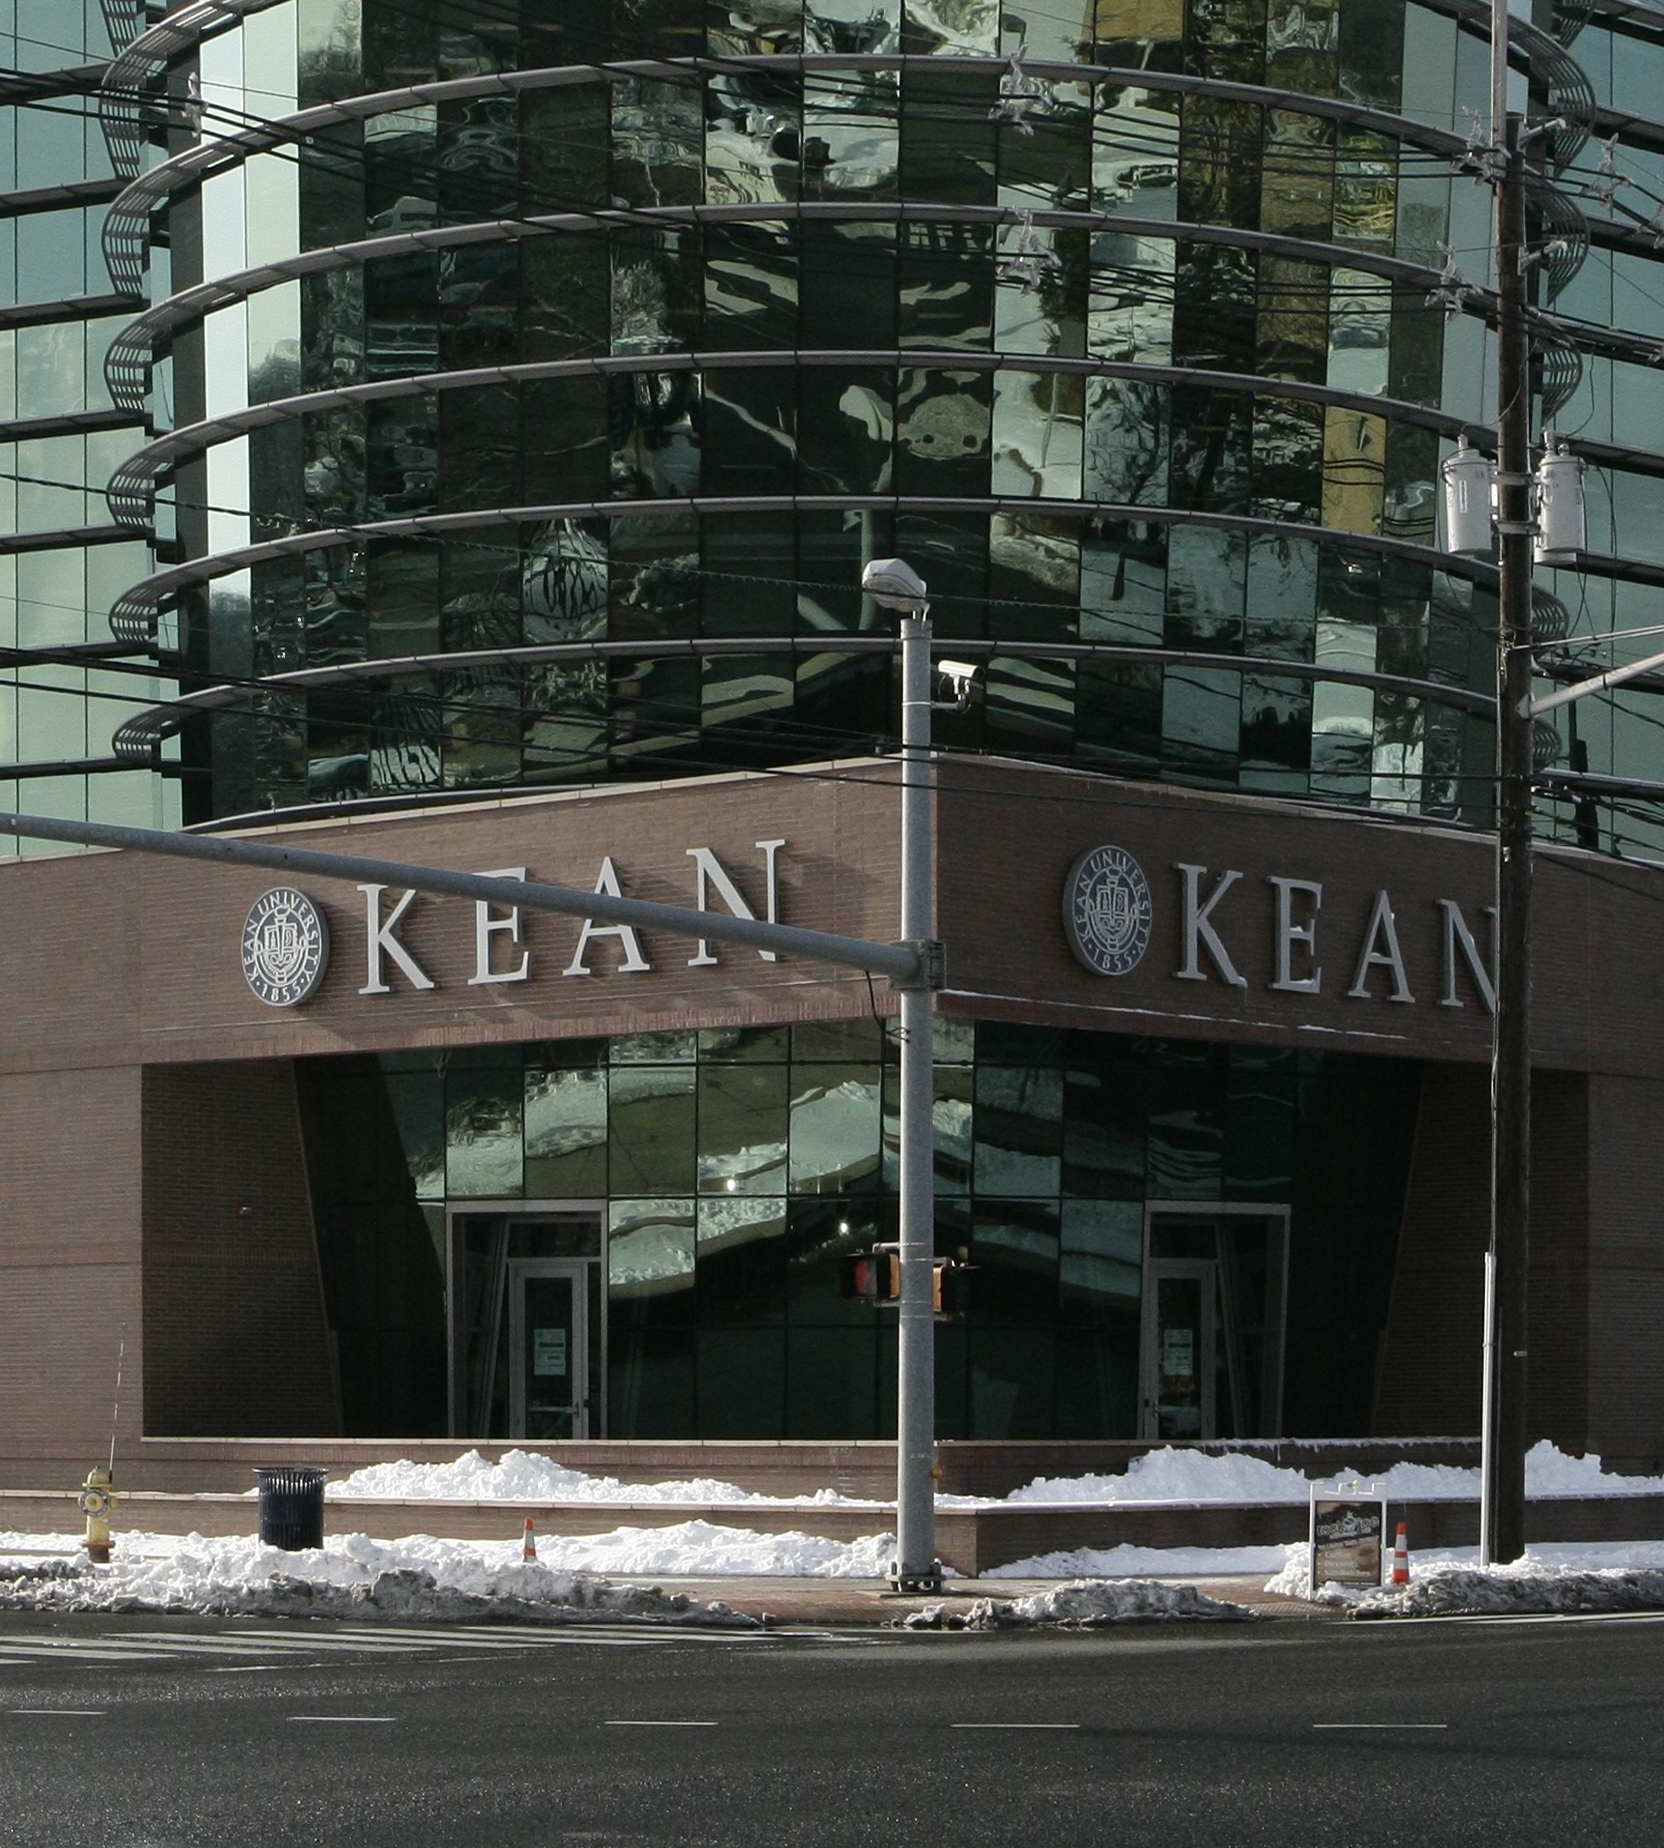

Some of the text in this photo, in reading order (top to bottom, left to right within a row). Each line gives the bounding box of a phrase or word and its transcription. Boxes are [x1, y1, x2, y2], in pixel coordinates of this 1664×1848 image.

[244, 891, 319, 983] KEAN UNIVERSITY
[356, 838, 787, 995] KEAN
[1090, 850, 1150, 954] UNIVERSITY
[1172, 862, 1499, 1014] KEAN
[261, 981, 301, 1002] 1855
[1092, 948, 1133, 971] 1855
